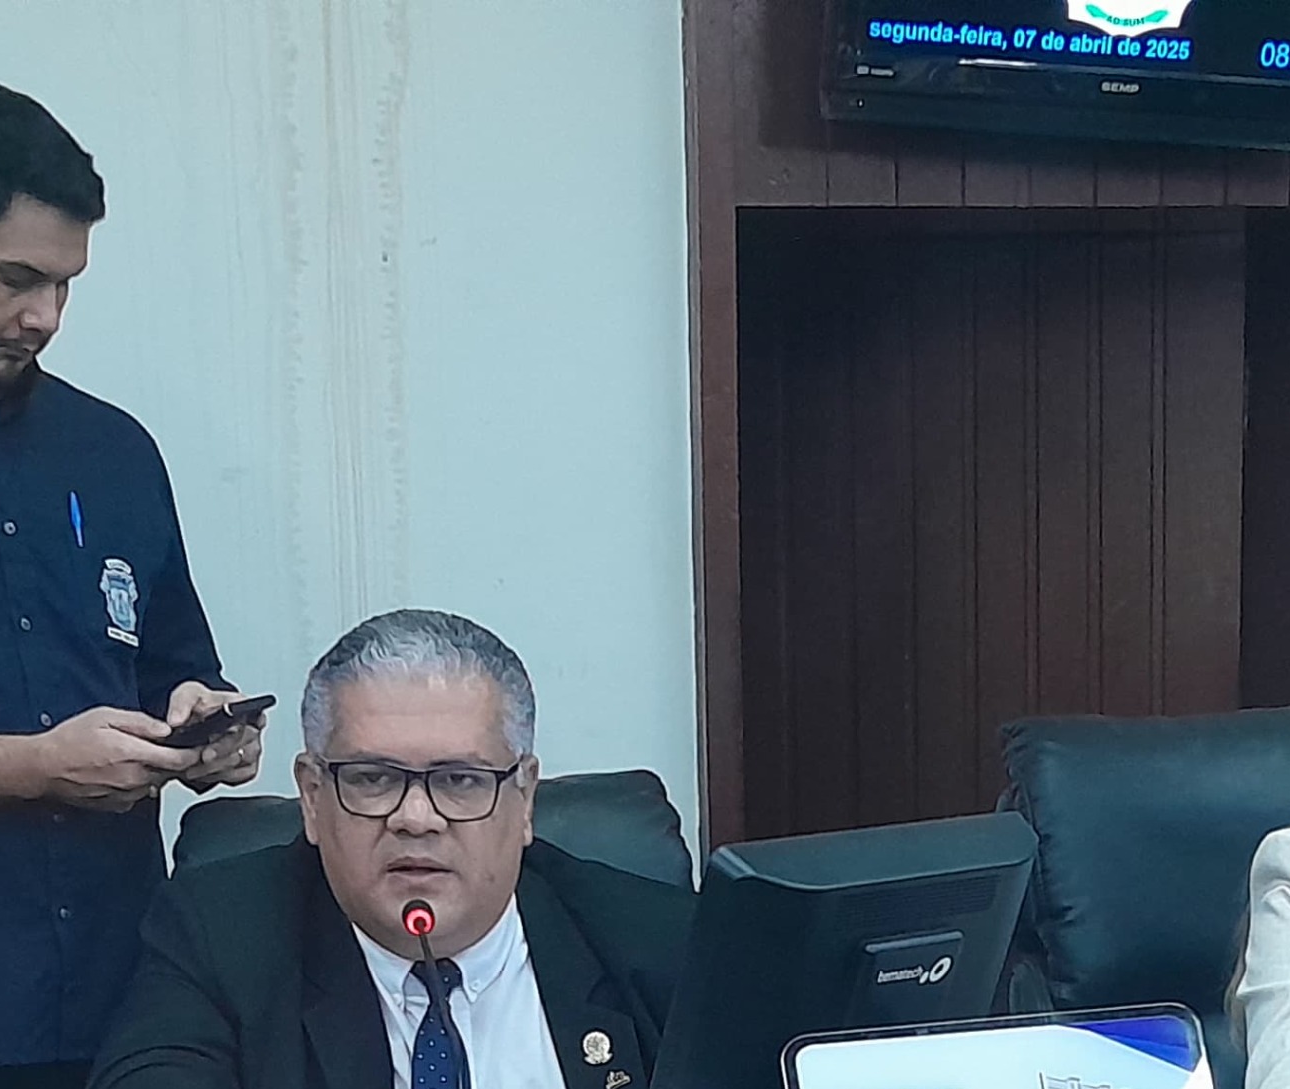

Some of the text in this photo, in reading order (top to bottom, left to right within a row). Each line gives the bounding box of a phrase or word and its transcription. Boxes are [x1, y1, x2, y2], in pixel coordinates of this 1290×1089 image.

[869, 20, 1191, 60] segunda-feira, 07 de abril de 2025
